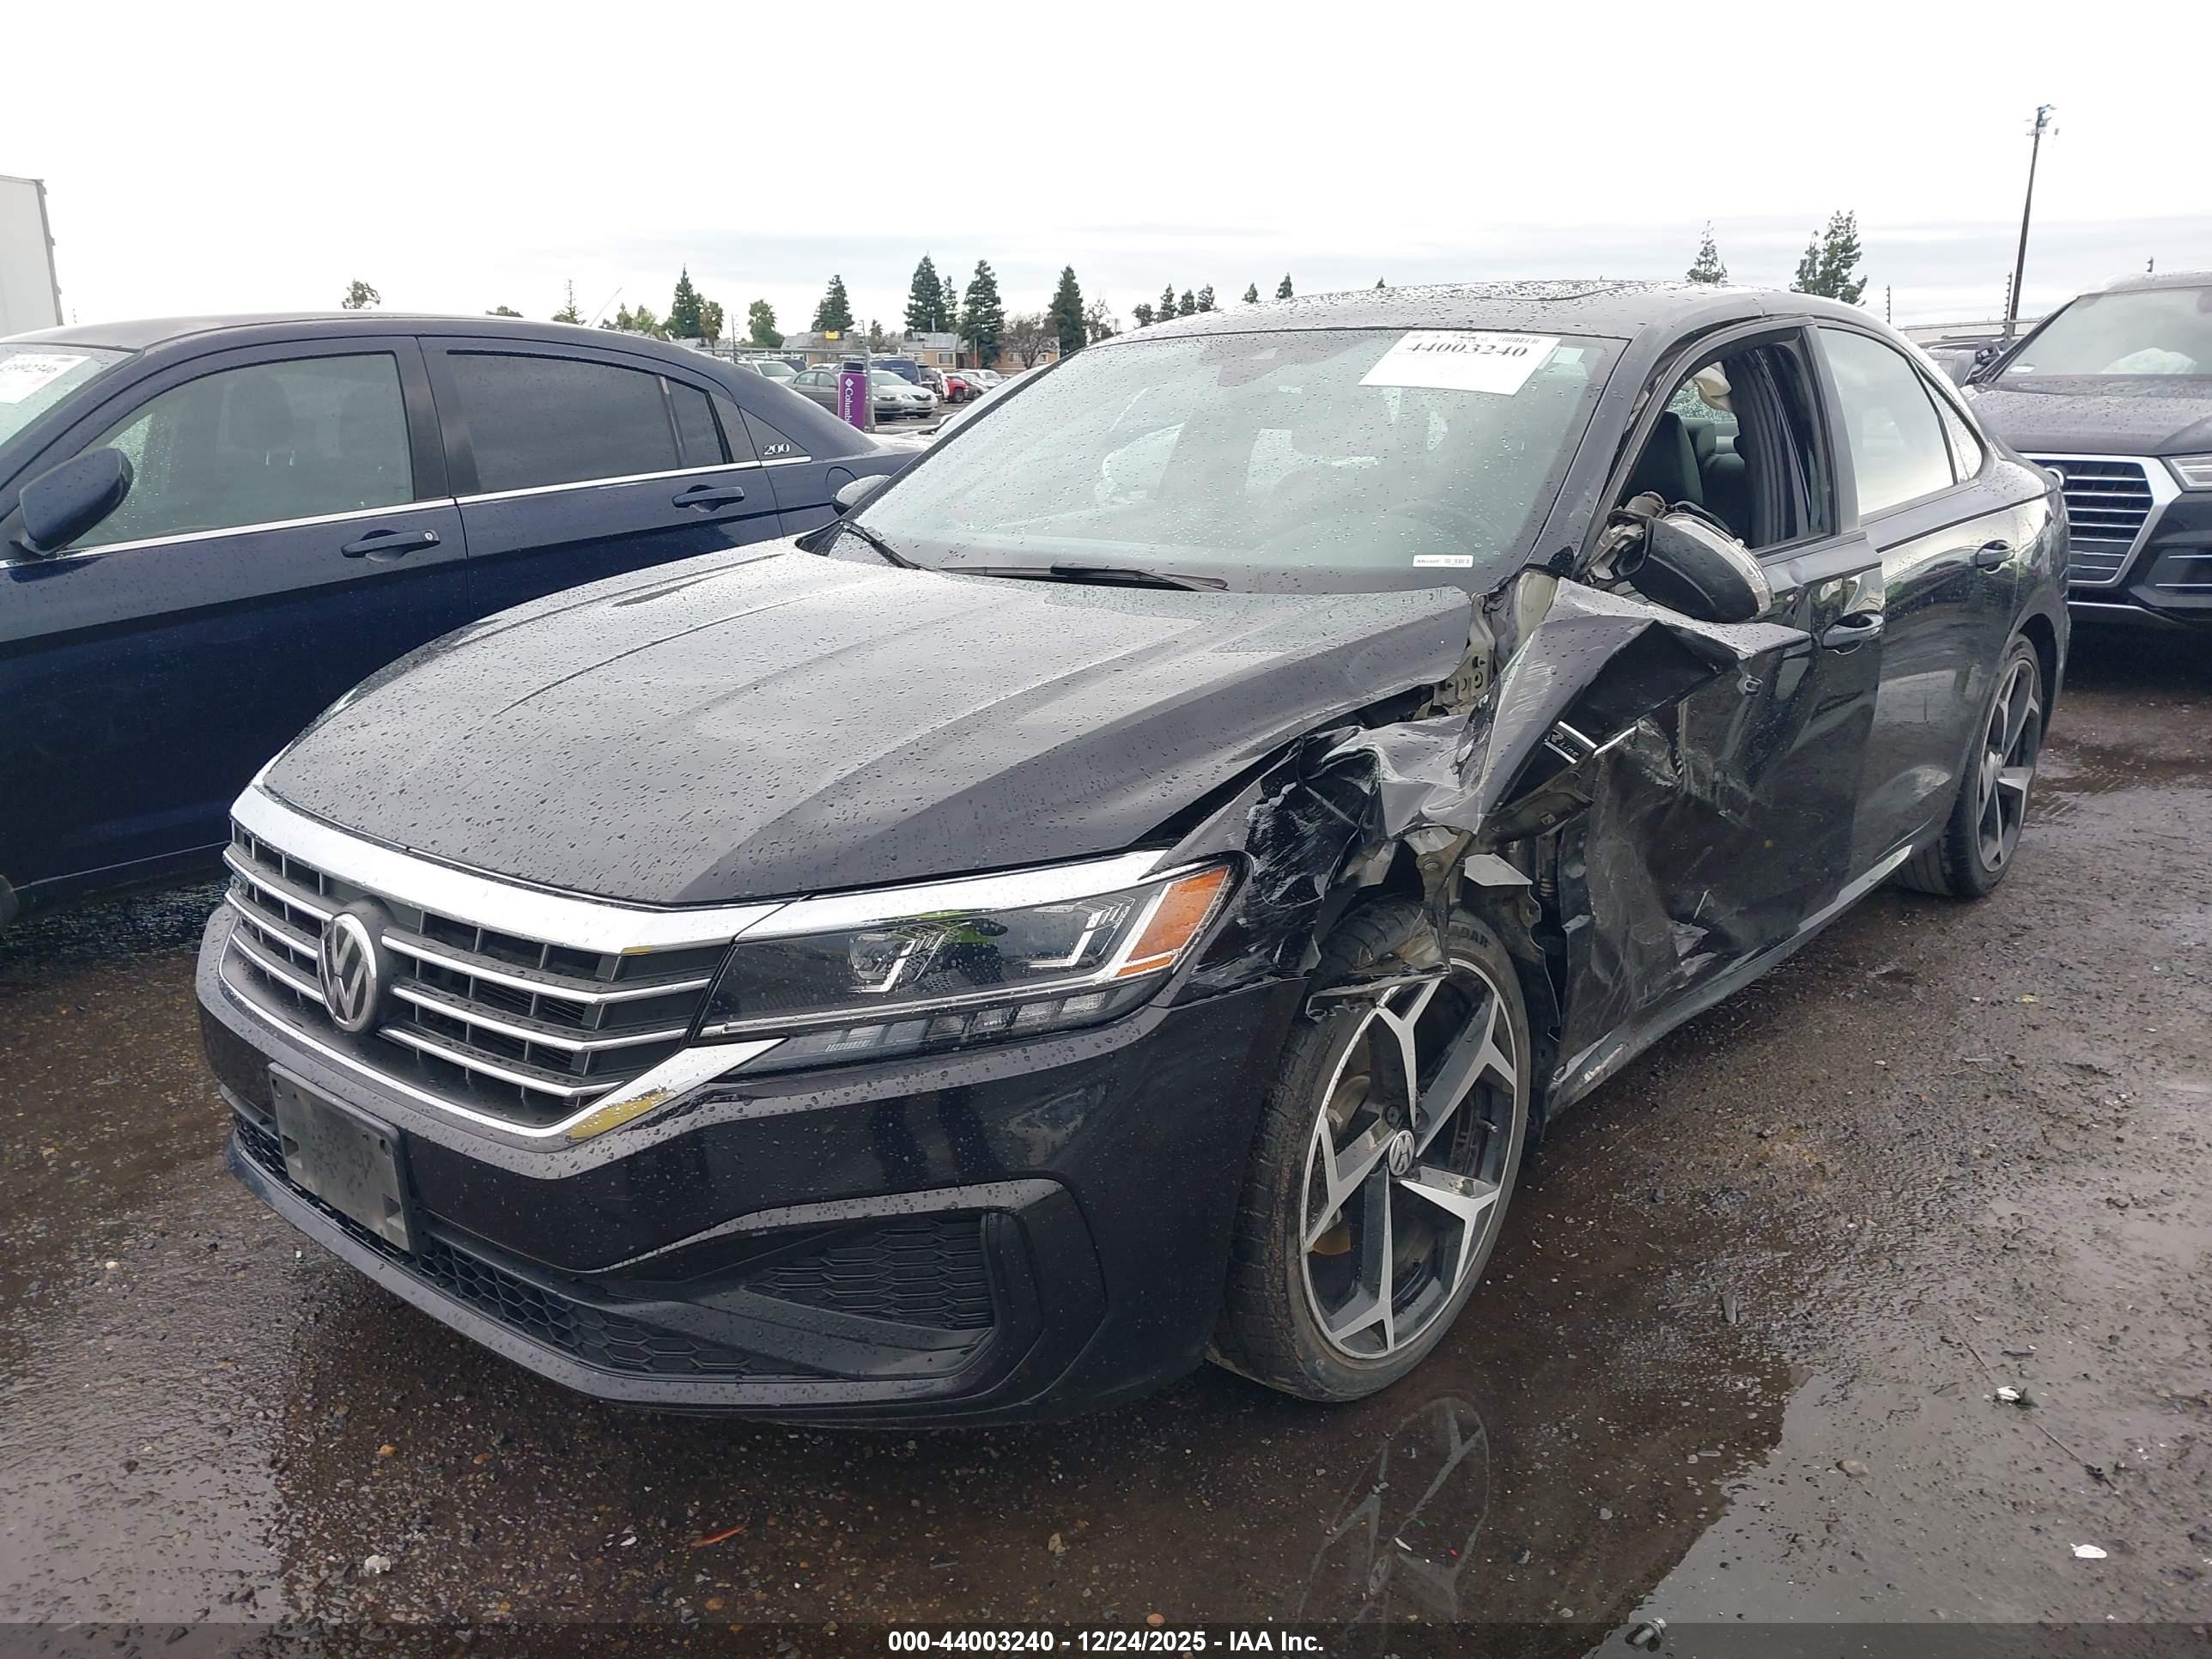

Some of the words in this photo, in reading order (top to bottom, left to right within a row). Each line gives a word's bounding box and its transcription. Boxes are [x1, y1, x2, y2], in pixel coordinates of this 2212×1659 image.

[1406, 342, 1528, 357] 44003240
[844, 387, 854, 424] Columbi
[763, 442, 791, 455] 200
